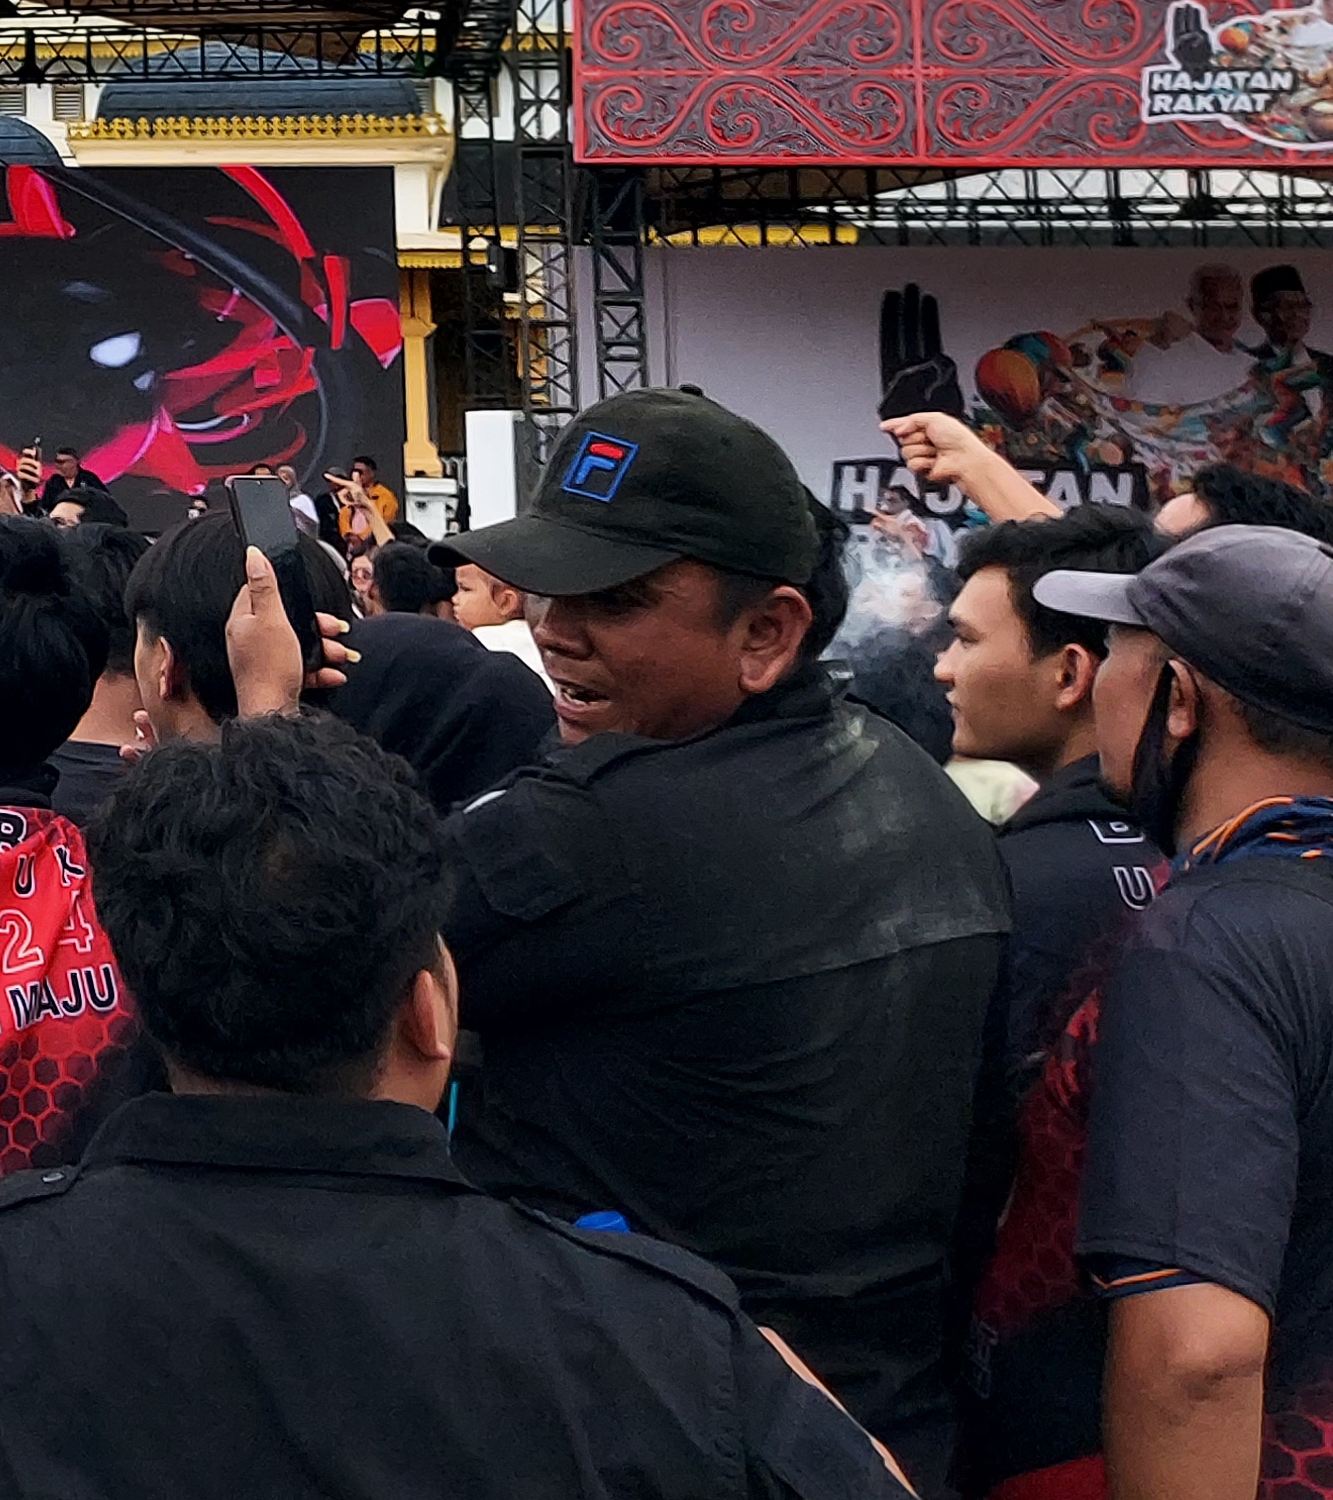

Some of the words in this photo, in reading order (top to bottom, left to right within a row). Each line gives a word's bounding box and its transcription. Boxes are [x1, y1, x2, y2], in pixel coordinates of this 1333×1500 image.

[1151, 70, 1295, 92] HAJATAN
[1151, 93, 1273, 113] RAKYAT
[839, 464, 1134, 515] HAJAN
[6, 963, 120, 1032] MAJU
